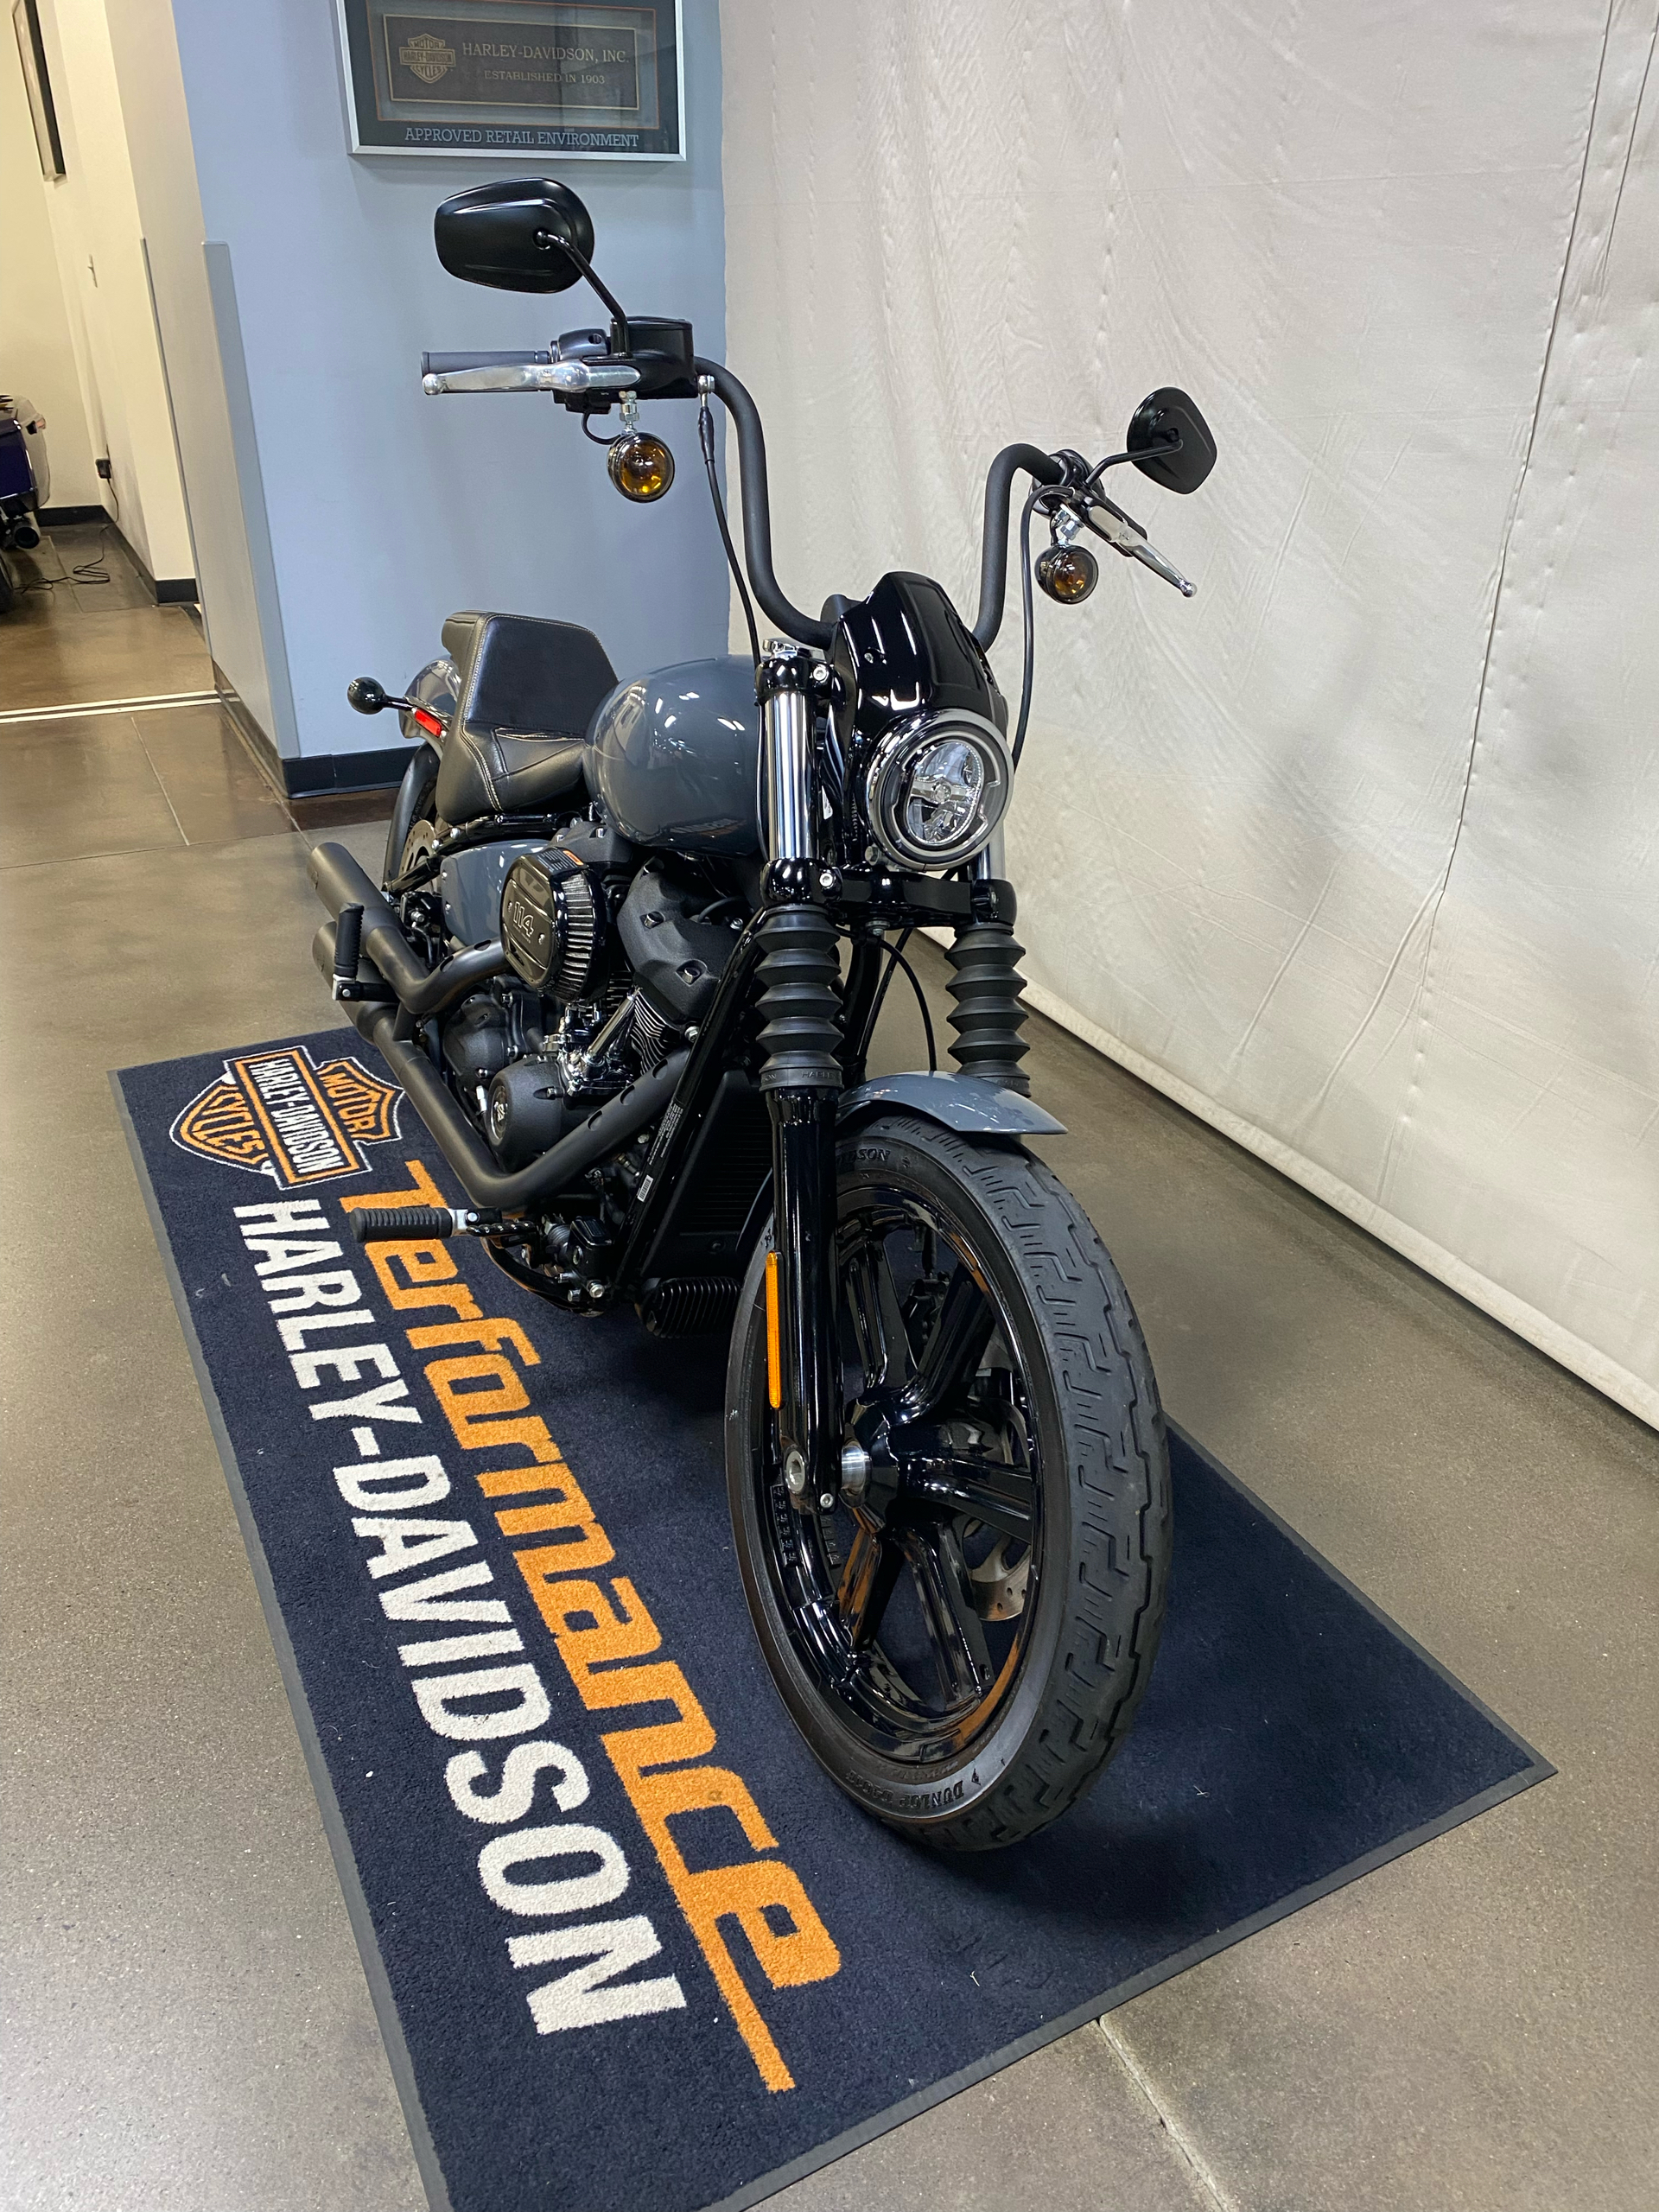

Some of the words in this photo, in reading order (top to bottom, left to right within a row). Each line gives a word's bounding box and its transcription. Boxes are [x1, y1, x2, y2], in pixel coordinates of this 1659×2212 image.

[462, 42, 599, 64] HARLEY-DAVIDSON,
[602, 49, 630, 63] INC.
[484, 70, 562, 83] ESTABLISHED
[565, 73, 576, 83] IN
[581, 74, 605, 85] 1903
[404, 127, 482, 143] APPROVED
[486, 130, 534, 144] RETAIL
[537, 131, 639, 147] ENVIRONMENT
[513, 901, 534, 938] 114
[249, 1058, 345, 1174] HARLEY-DAVIDSON
[319, 1072, 381, 1133] MOTOR
[190, 1092, 265, 1154] CYCLES
[232, 1198, 688, 2036] HARLEY-DAVIDSON
[899, 1780, 964, 1809] DUNLOP
